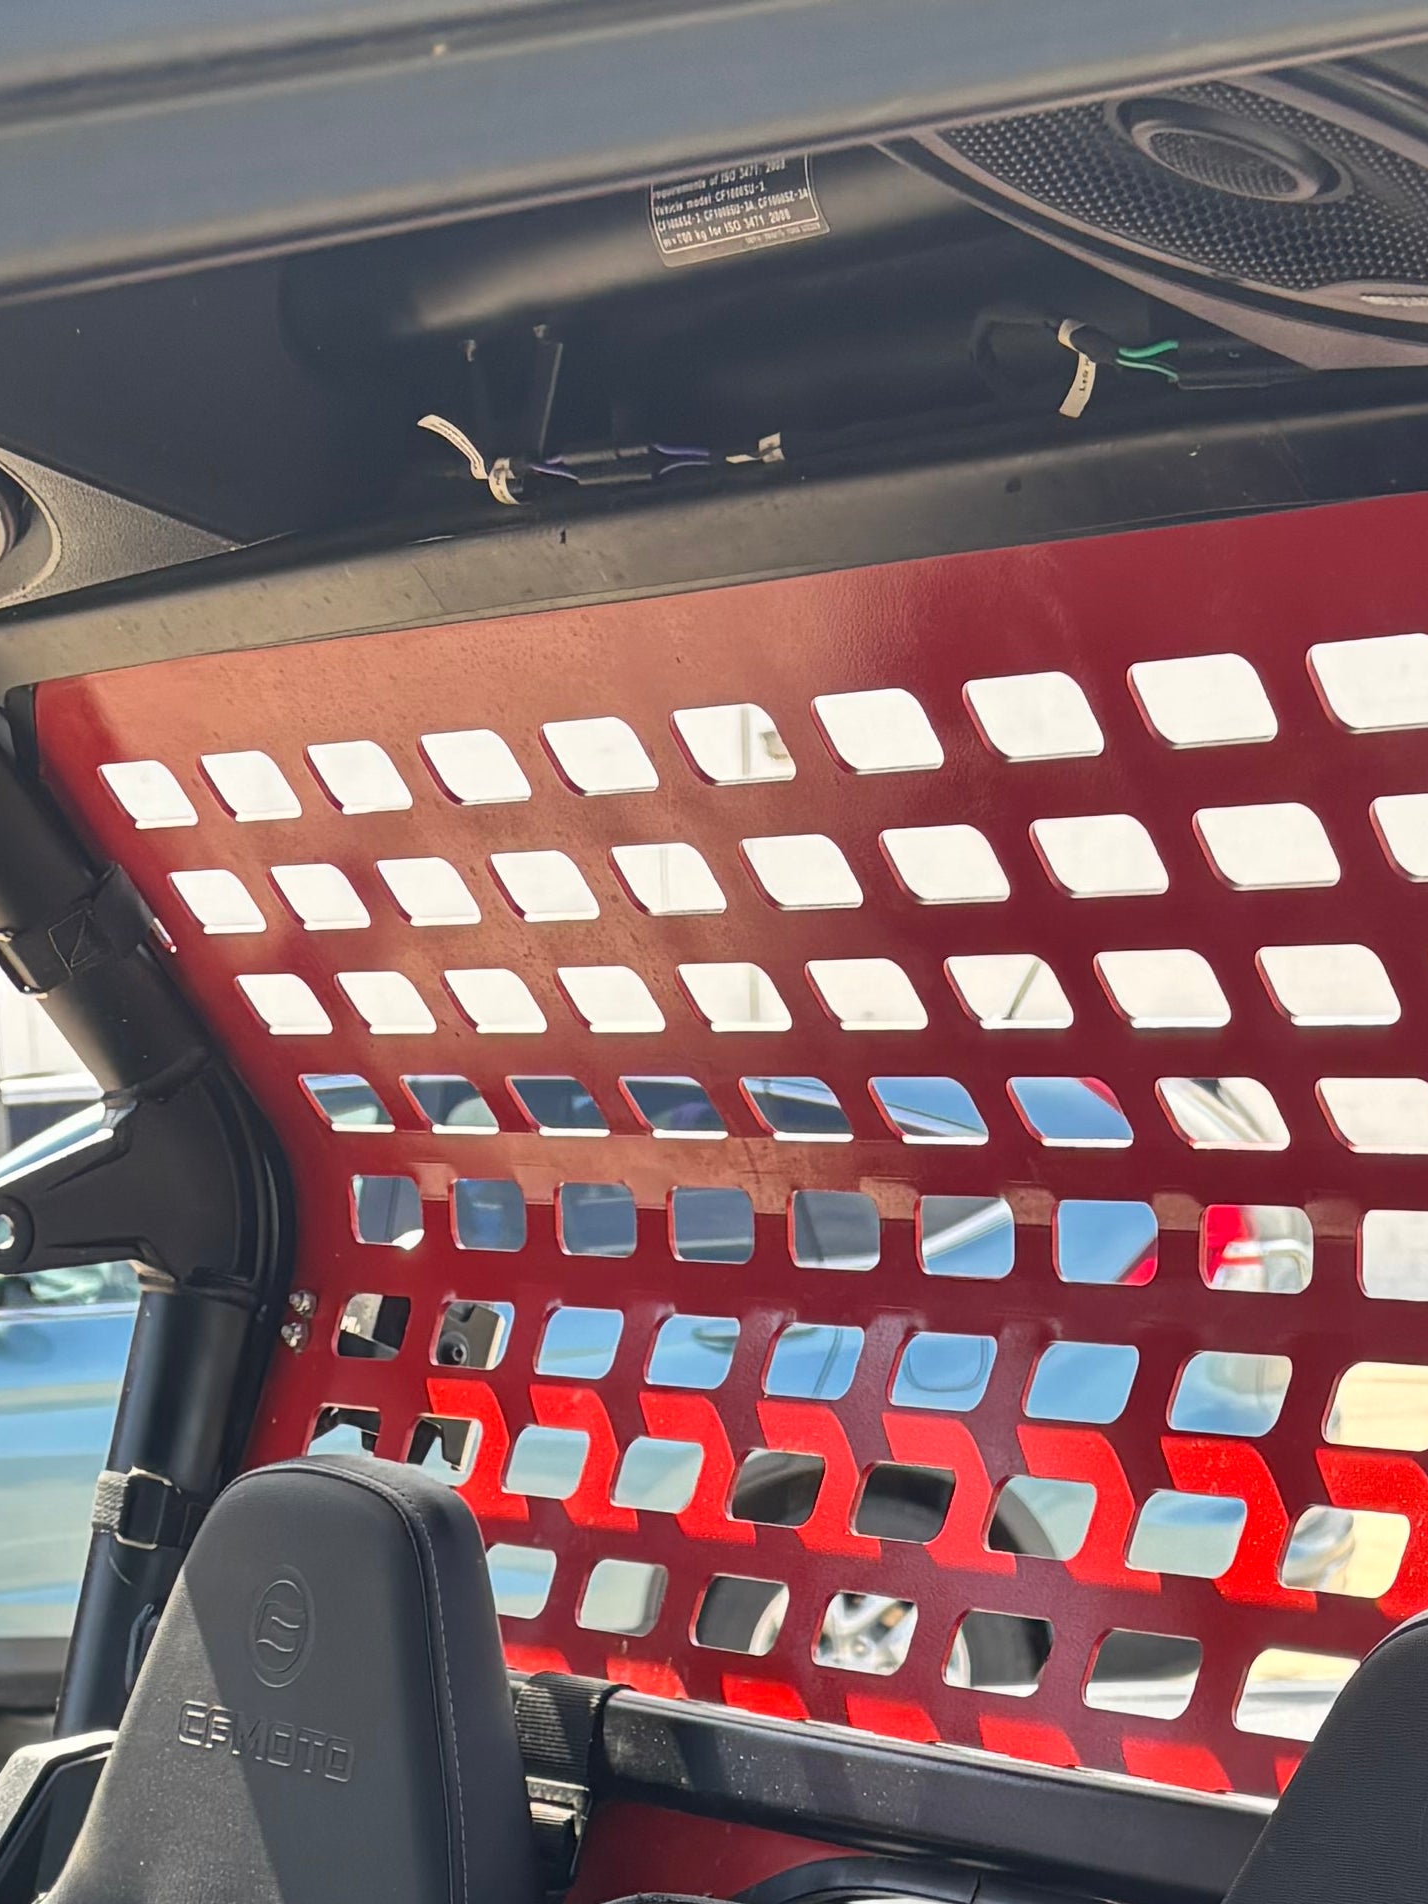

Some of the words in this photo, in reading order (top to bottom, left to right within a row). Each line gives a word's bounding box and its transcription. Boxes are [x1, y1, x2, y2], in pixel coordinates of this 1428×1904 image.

[721, 168, 736, 184] ISO
[723, 219, 741, 234] ISO
[178, 1699, 355, 1783] CFMOTO
